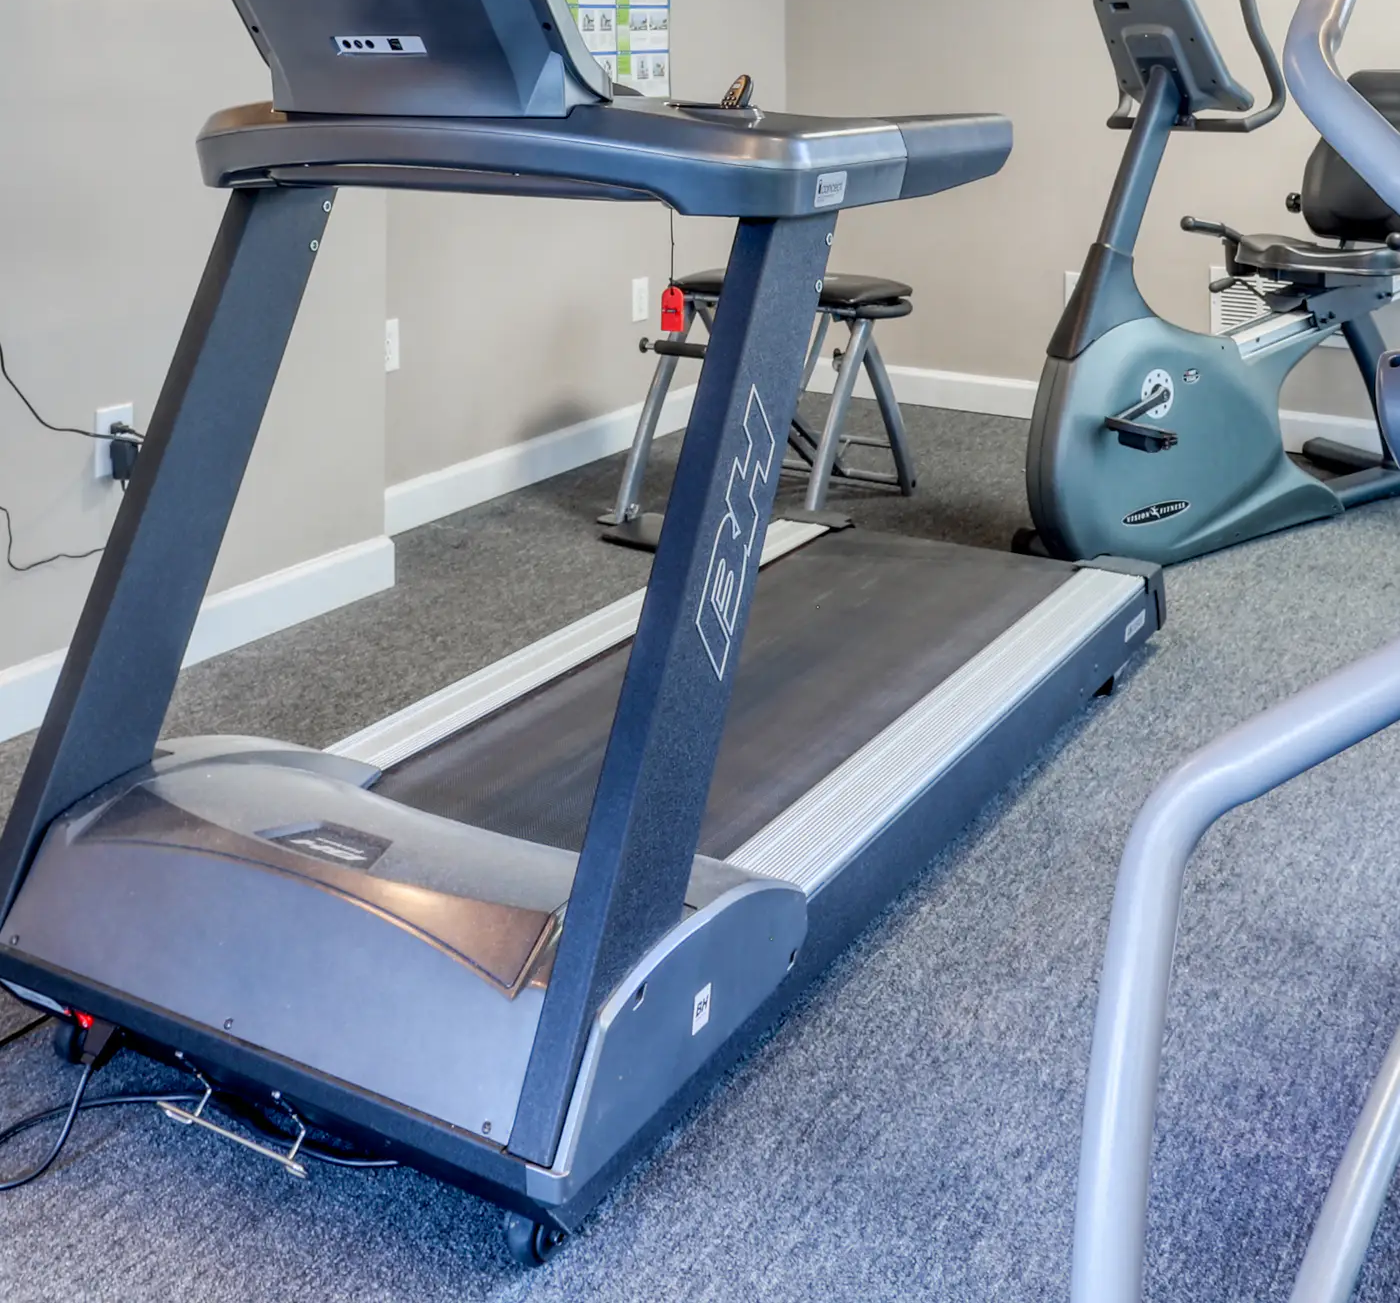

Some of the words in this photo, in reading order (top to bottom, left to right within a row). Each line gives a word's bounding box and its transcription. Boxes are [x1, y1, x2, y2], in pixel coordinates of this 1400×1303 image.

[1126, 512, 1150, 522] VISION
[1160, 502, 1185, 514] FITNESS
[695, 993, 709, 1018] BH
